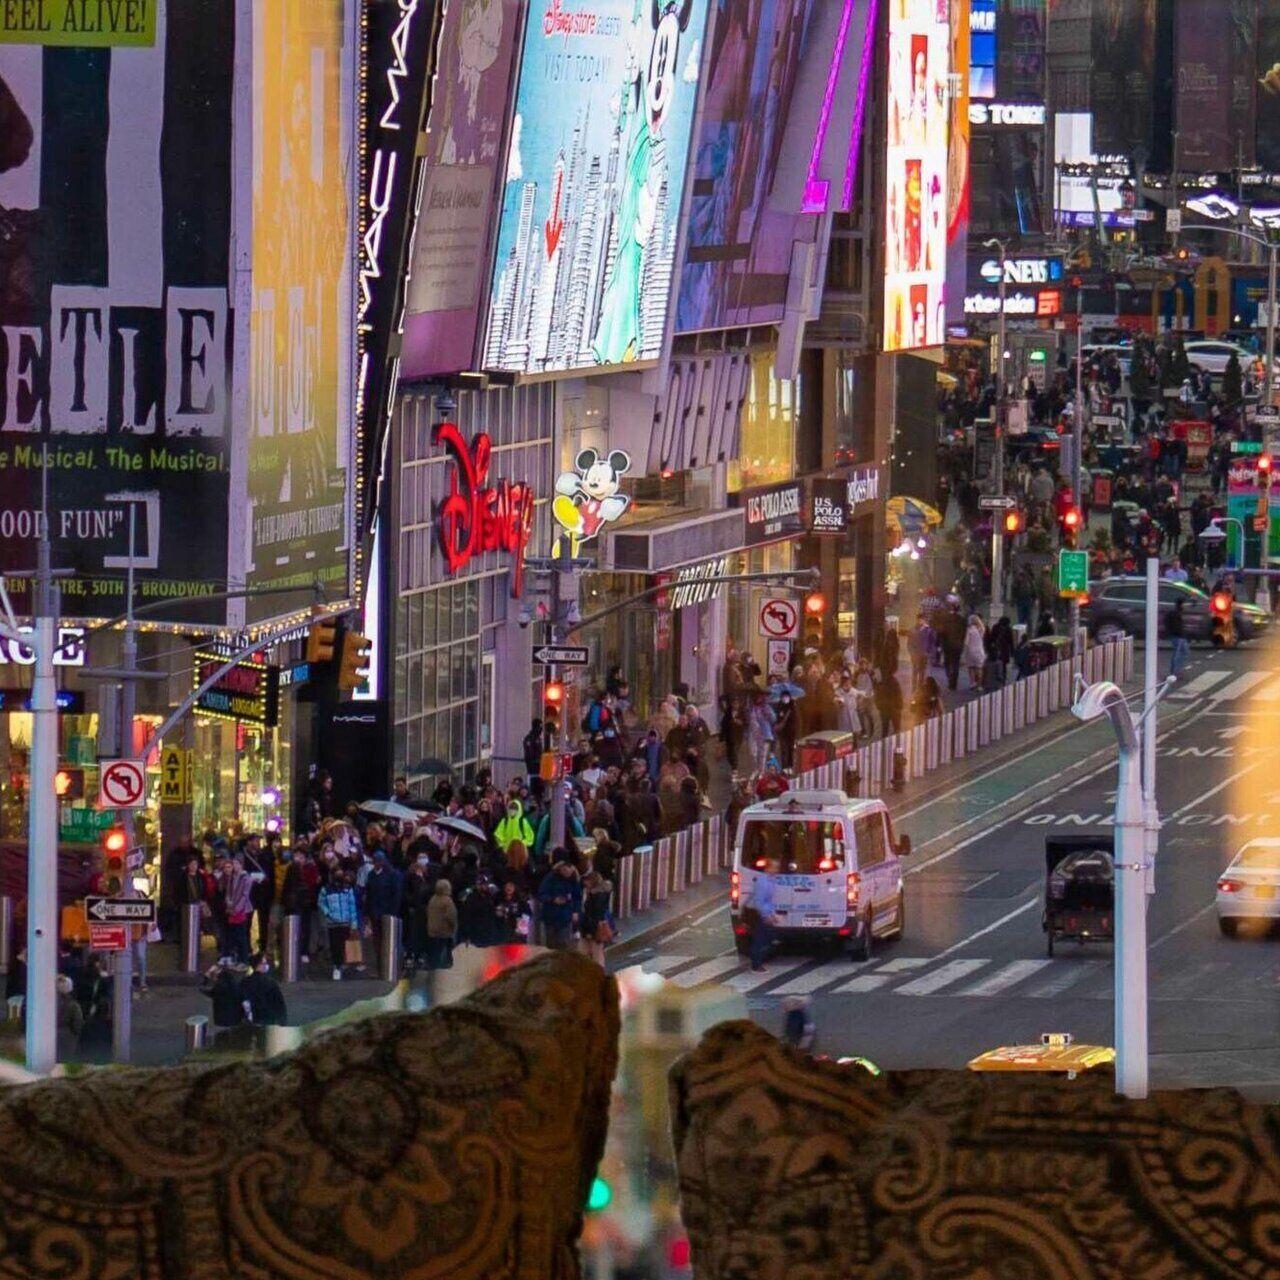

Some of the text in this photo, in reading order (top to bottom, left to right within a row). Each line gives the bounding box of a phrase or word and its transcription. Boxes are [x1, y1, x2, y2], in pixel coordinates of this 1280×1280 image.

[62, 0, 148, 33] ALIVE!
[13, 445, 98, 471] Musical.
[105, 447, 142, 471] The
[814, 507, 842, 516] POLO
[92, 579, 124, 596] 50TH
[142, 581, 216, 598] BROADWAY
[540, 650, 583, 660] ONE WAY
[165, 754, 181, 796] ATM
[96, 904, 146, 914] ONE WAY
